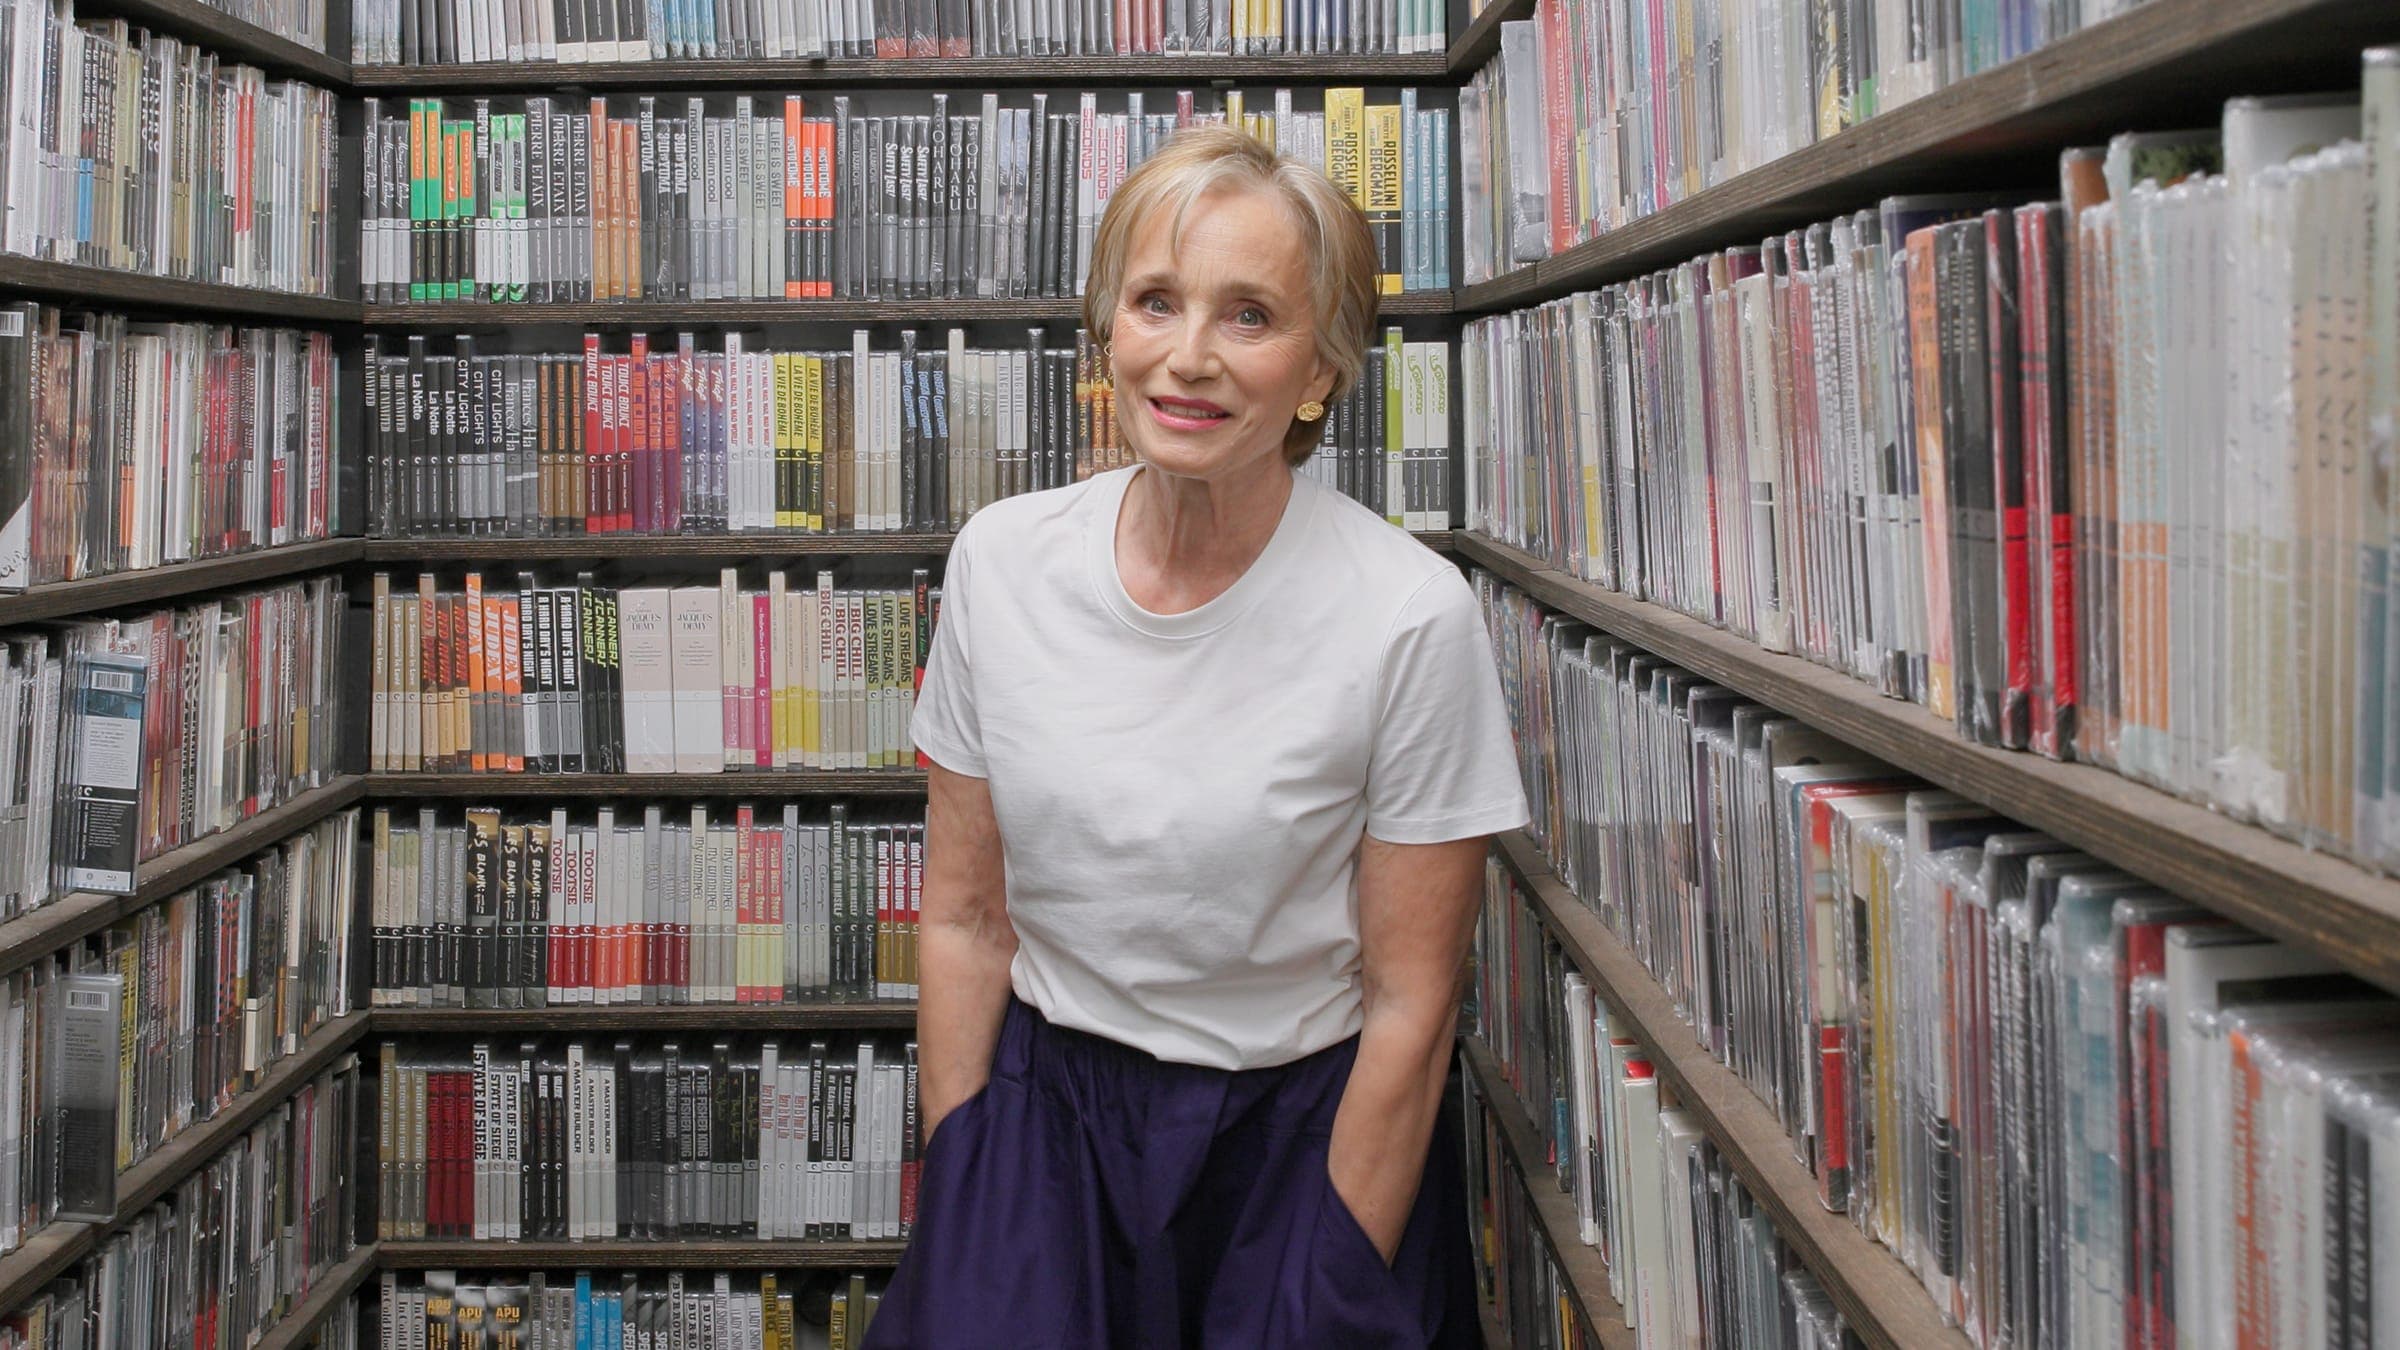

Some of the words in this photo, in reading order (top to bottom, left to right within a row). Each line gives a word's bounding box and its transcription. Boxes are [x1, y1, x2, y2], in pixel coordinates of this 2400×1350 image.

[477, 108, 488, 132] REPO
[689, 109, 699, 154] medium
[739, 108, 749, 128] LIFE
[477, 136, 488, 158] MAN
[530, 111, 544, 159] PIERRE
[553, 118, 566, 166] PIERRE
[739, 133, 749, 144] IS
[771, 131, 781, 152] LIFE
[1082, 108, 1092, 179] SECONDS
[707, 131, 717, 176] medium
[739, 150, 749, 184] SWEET
[771, 158, 781, 167] IS
[885, 143, 898, 174] SAFETY
[916, 145, 929, 177] SAFETY
[933, 130, 945, 204] OHARU
[1098, 128, 1108, 200] SECONDS
[691, 157, 701, 180] cool
[950, 144, 962, 210] OHARU
[1383, 141, 1396, 206] ROSSELLINI
[530, 164, 544, 207] ETAIX
[553, 172, 566, 212] ETAIX
[708, 179, 718, 202] cool
[771, 173, 781, 208] SWEET
[459, 360, 468, 388] CITY
[587, 347, 598, 378] TOUKI
[777, 365, 787, 377] LA
[793, 365, 802, 377] LA
[413, 374, 423, 387] La
[473, 371, 484, 399] CITY
[602, 365, 613, 395] TOUKI
[777, 378, 787, 388] VIE
[793, 379, 802, 389] VIE
[413, 390, 423, 420] Notte
[430, 392, 439, 404] La
[506, 382, 520, 432] Frances
[522, 379, 536, 426] Frances
[587, 380, 598, 412] BOUKI
[777, 391, 787, 401] DE
[793, 391, 802, 401] DE
[430, 406, 439, 435] Notte
[459, 393, 468, 433] LIGHTS
[473, 404, 484, 445] LIGHTS
[602, 398, 613, 430] BOUKI
[1342, 406, 1350, 432] HOUSE
[376, 596, 385, 610] Like
[520, 598, 532, 624] HARD
[561, 604, 572, 628] HARD
[821, 590, 831, 616] BIG
[867, 603, 877, 628] LOVE
[883, 600, 894, 625] LOVE
[376, 613, 385, 646] Someone
[454, 606, 465, 633] RED
[468, 584, 481, 659] JUDEX
[582, 588, 594, 663] SCANNERS
[595, 598, 606, 667] SCANNERS
[851, 608, 861, 634] BIG
[486, 607, 500, 680] JUDEX
[522, 626, 533, 648] DAY'S
[562, 631, 574, 656] DAY'S
[821, 619, 831, 663] CHILL
[376, 658, 385, 674] Love
[455, 638, 466, 681] RIVER
[524, 651, 535, 678] NIGHT
[851, 636, 861, 680] CHILL
[868, 633, 879, 683] STREAMS
[883, 629, 894, 680] STREAMS
[564, 658, 575, 685] NIGHT
[475, 825, 488, 847] LES
[506, 831, 518, 853] LES
[834, 821, 842, 844] EVERY
[552, 839, 563, 893] TOOTSIE
[879, 841, 889, 865] don't
[895, 842, 905, 865] don't
[568, 851, 577, 905] TOOTSIE
[834, 866, 842, 881] FOR
[879, 889, 889, 910] now
[895, 890, 905, 910] now
[474, 1053, 486, 1097] STATE
[680, 1077, 690, 1094] THE
[906, 1064, 918, 1108] DRESSED
[491, 1074, 500, 1109] STATE
[474, 1100, 486, 1113] OF
[491, 1112, 500, 1123] OF
[680, 1097, 690, 1131] FISHER
[907, 1111, 916, 1124] TO
[474, 1119, 486, 1160] SIEGE
[491, 1128, 500, 1159] SIEGE
[680, 1134, 690, 1156] KING
[2350, 1177, 2367, 1300] INLAND
[383, 1285, 392, 1296] In
[383, 1298, 392, 1323] Cold
[458, 1307, 482, 1318] APU
[496, 1307, 520, 1318] APU
